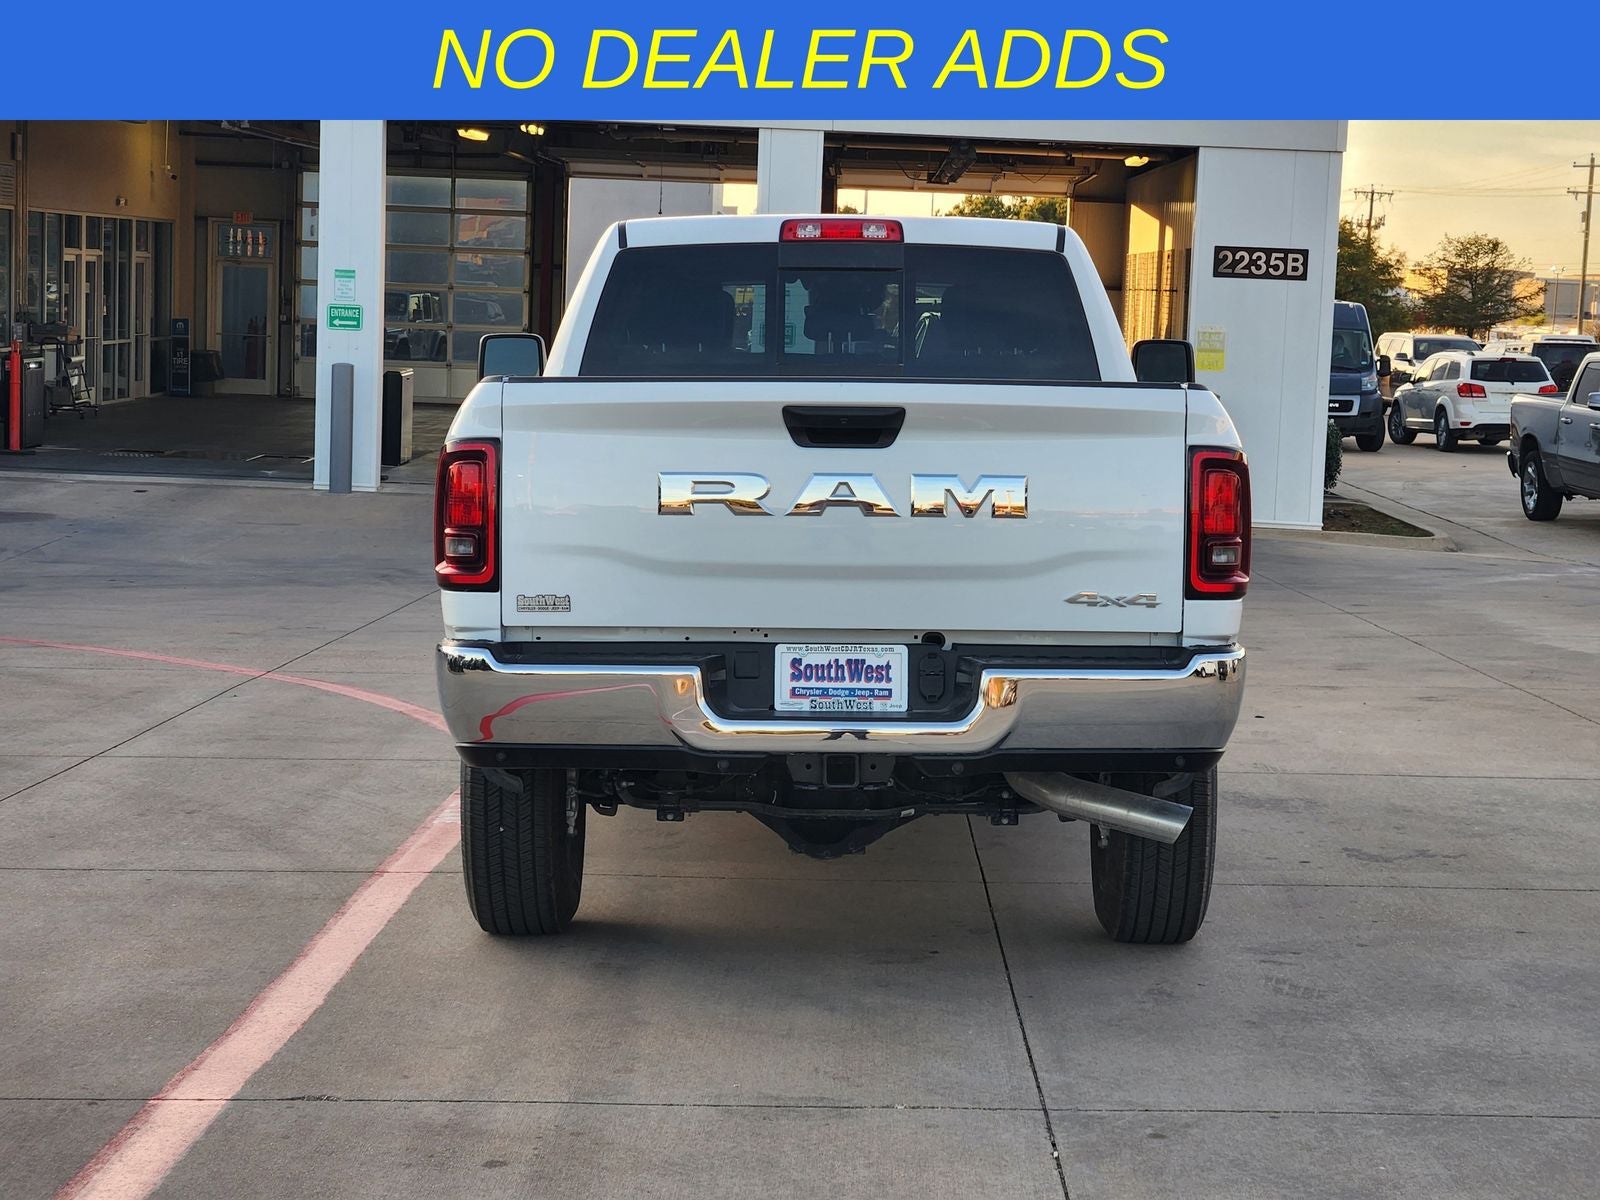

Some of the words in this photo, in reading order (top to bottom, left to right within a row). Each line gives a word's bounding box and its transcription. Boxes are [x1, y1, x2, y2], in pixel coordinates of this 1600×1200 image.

[1217, 250, 1304, 276] 2235B
[330, 308, 360, 318] ENTRANCE
[657, 471, 1030, 519] RAM
[789, 657, 893, 684] SouthWest
[795, 688, 822, 696] Chrysler
[828, 689, 849, 697] Dodge
[809, 699, 874, 711] SouthWest
